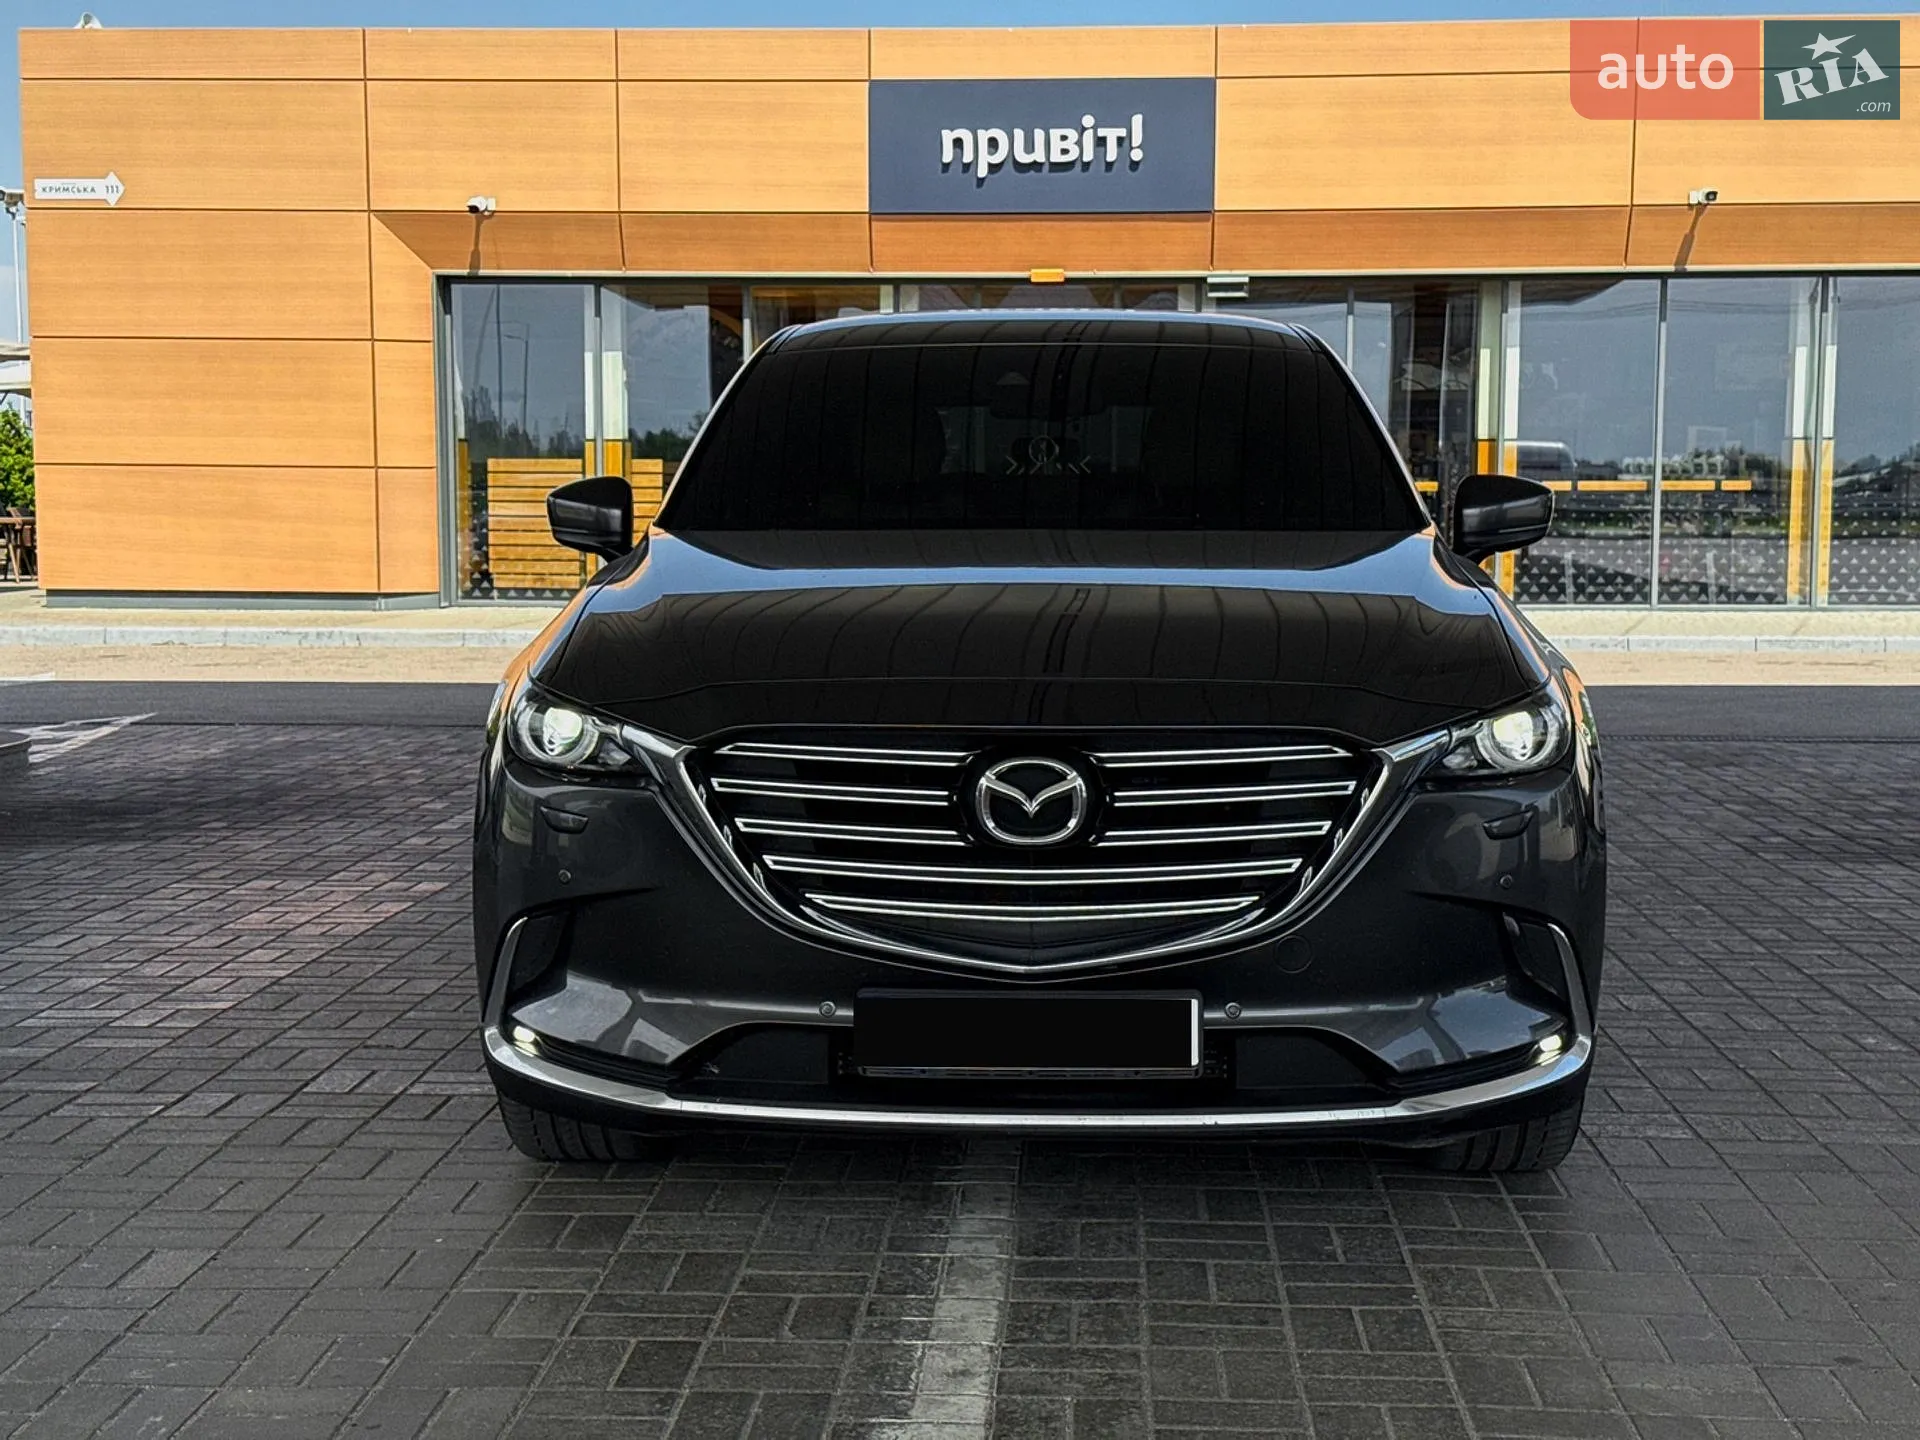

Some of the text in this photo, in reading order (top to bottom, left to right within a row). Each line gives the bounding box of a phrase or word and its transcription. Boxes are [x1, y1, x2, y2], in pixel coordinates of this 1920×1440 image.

[941, 113, 1144, 178] привіт!
[41, 185, 119, 194] КРИМСЬКА 111
